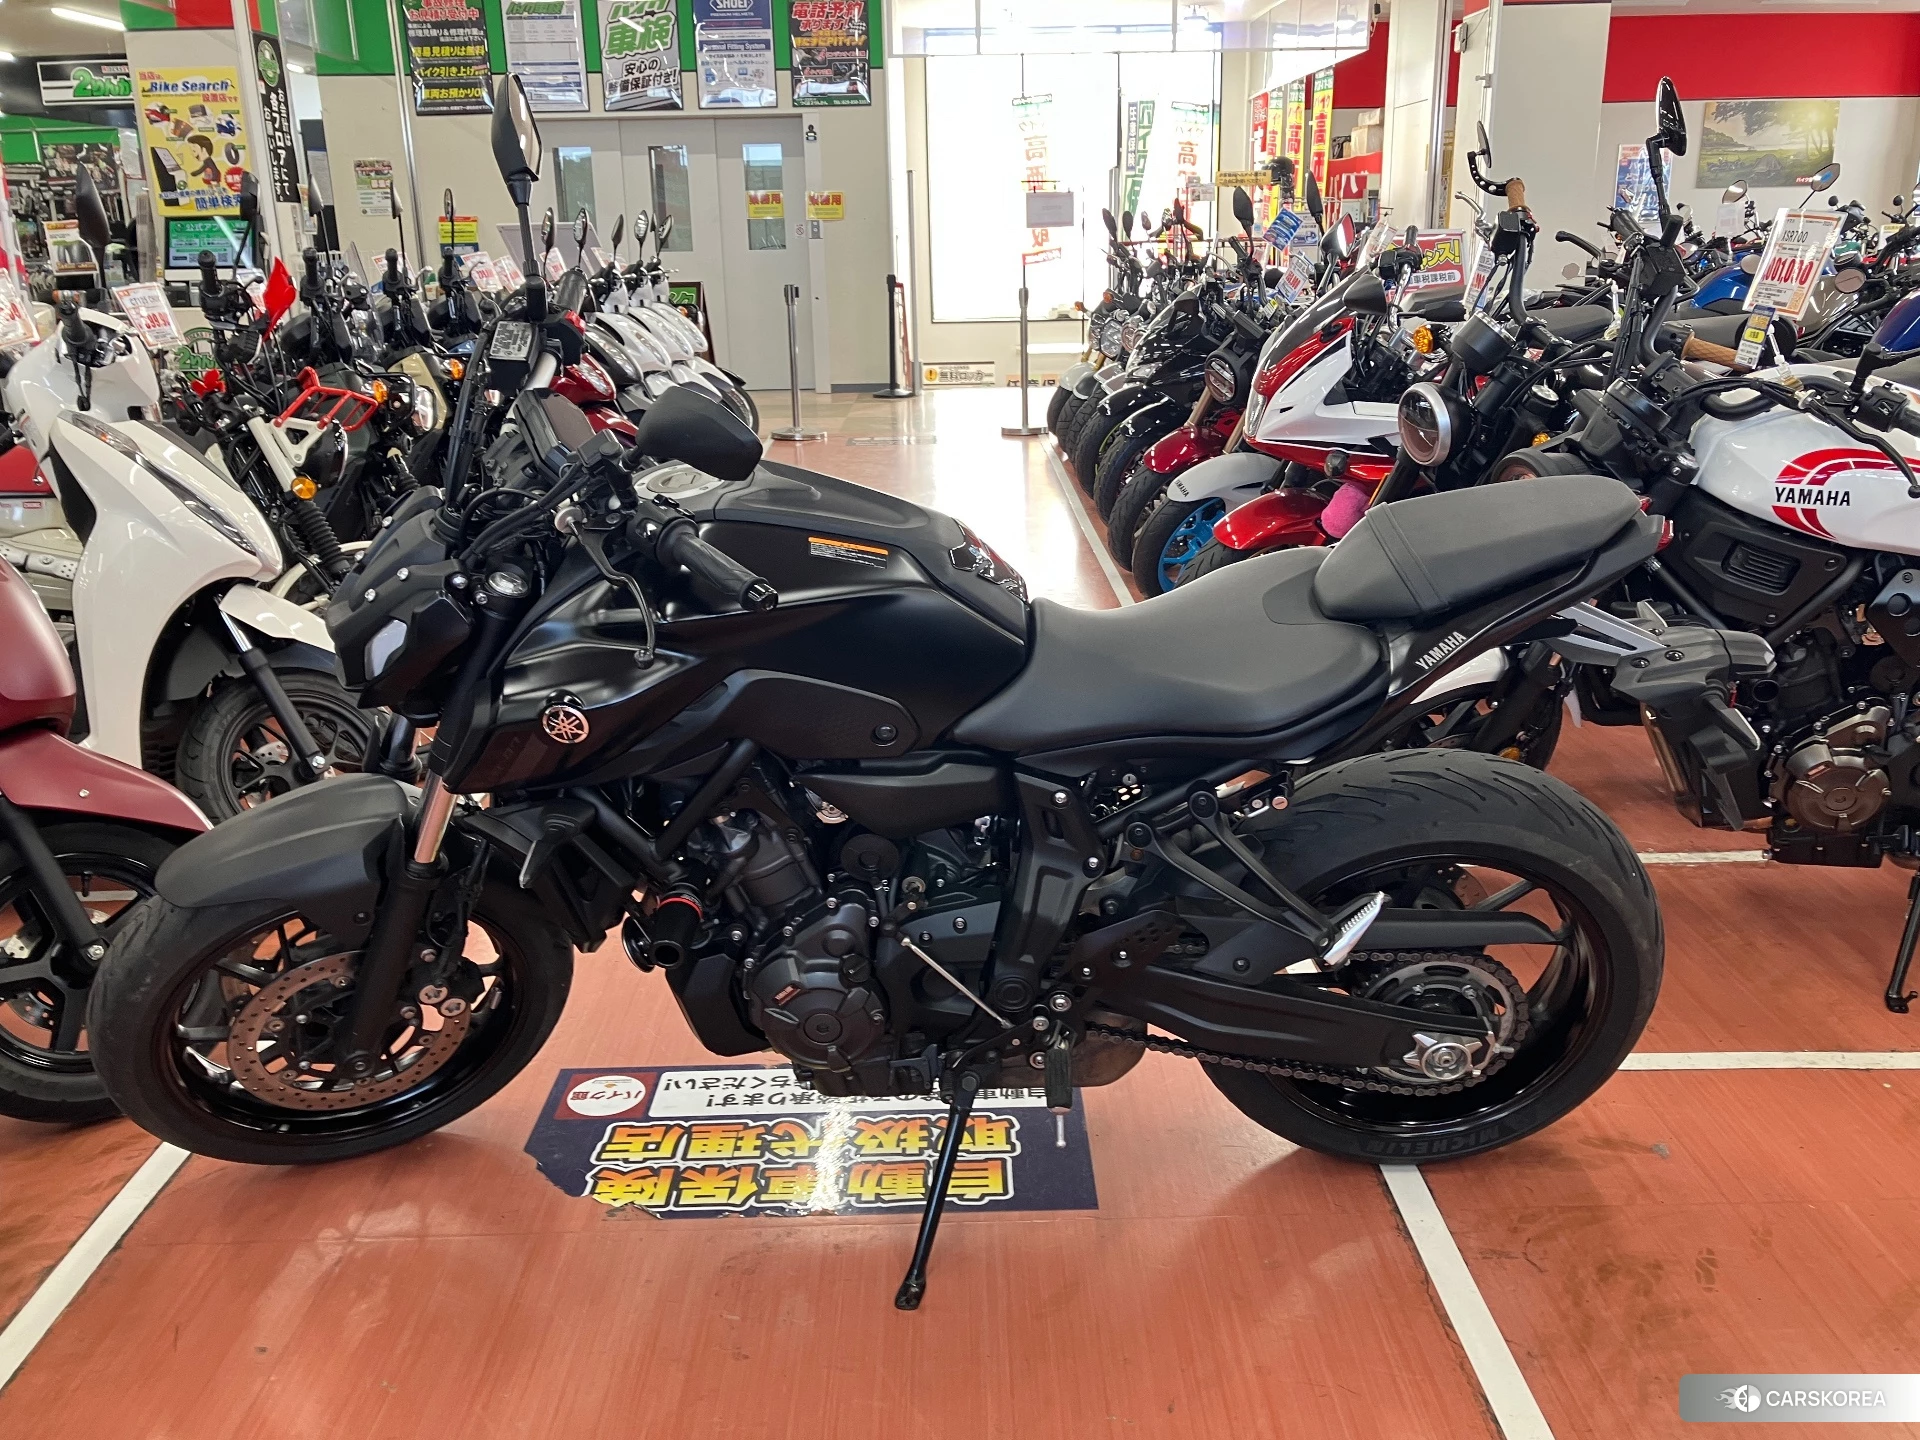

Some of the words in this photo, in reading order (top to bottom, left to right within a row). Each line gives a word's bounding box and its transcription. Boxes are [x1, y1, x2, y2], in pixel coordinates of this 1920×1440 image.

[793, 1, 863, 20] 電話予約
[624, 60, 659, 77] 安心の
[150, 81, 179, 92] Bike
[181, 80, 229, 91] Search
[1780, 230, 1809, 244] XSR700
[1409, 271, 1456, 284] 車税課税前
[1774, 486, 1851, 507] YAMAHA
[1415, 631, 1467, 670] YAMAHA
[570, 1089, 644, 1101] バイク館
[602, 1117, 1013, 1160] 取扱代理店
[1366, 1125, 1500, 1154] MICHELIN
[593, 1160, 1003, 1206] 自動車保険
